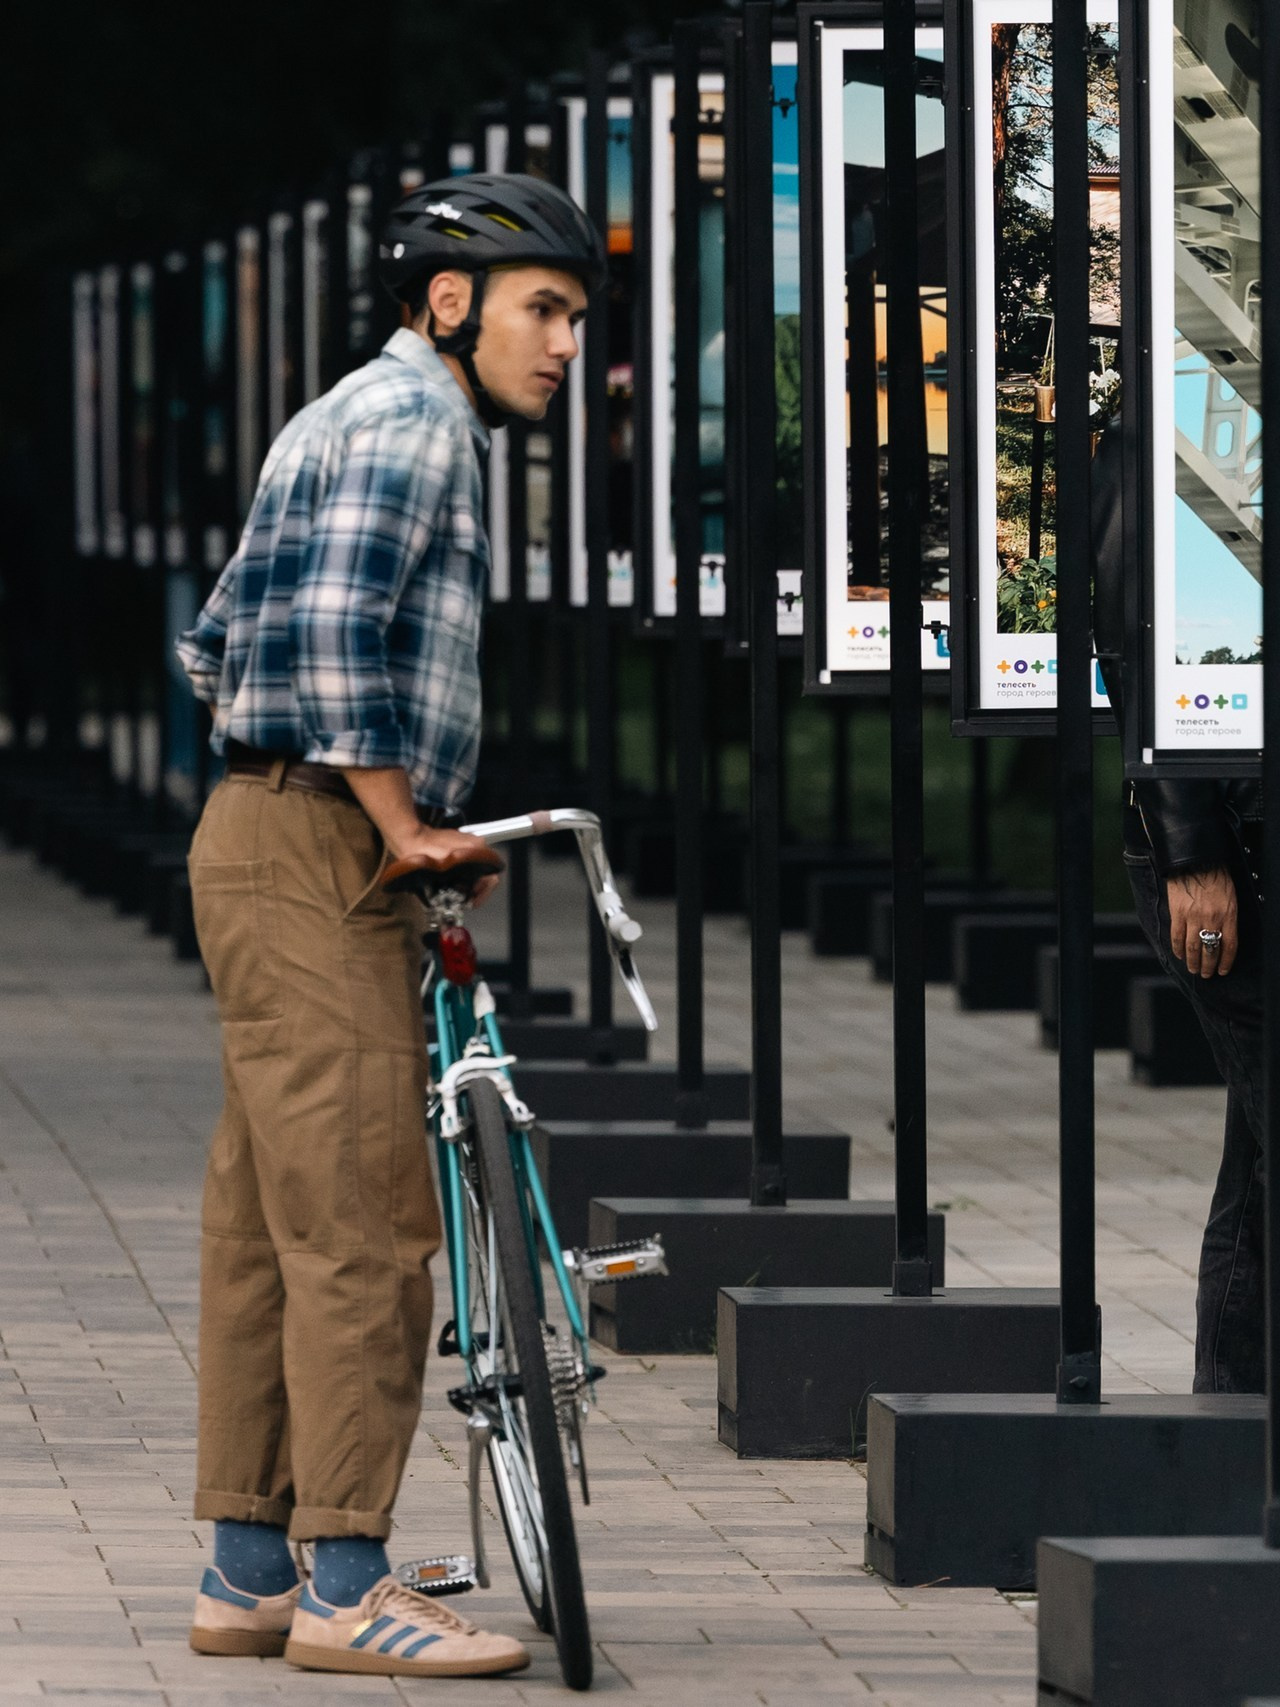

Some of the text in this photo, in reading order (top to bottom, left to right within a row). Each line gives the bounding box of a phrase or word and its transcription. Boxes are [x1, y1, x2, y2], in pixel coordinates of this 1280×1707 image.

[996, 690, 1057, 698] город героев
[1175, 728, 1242, 737] город героев
